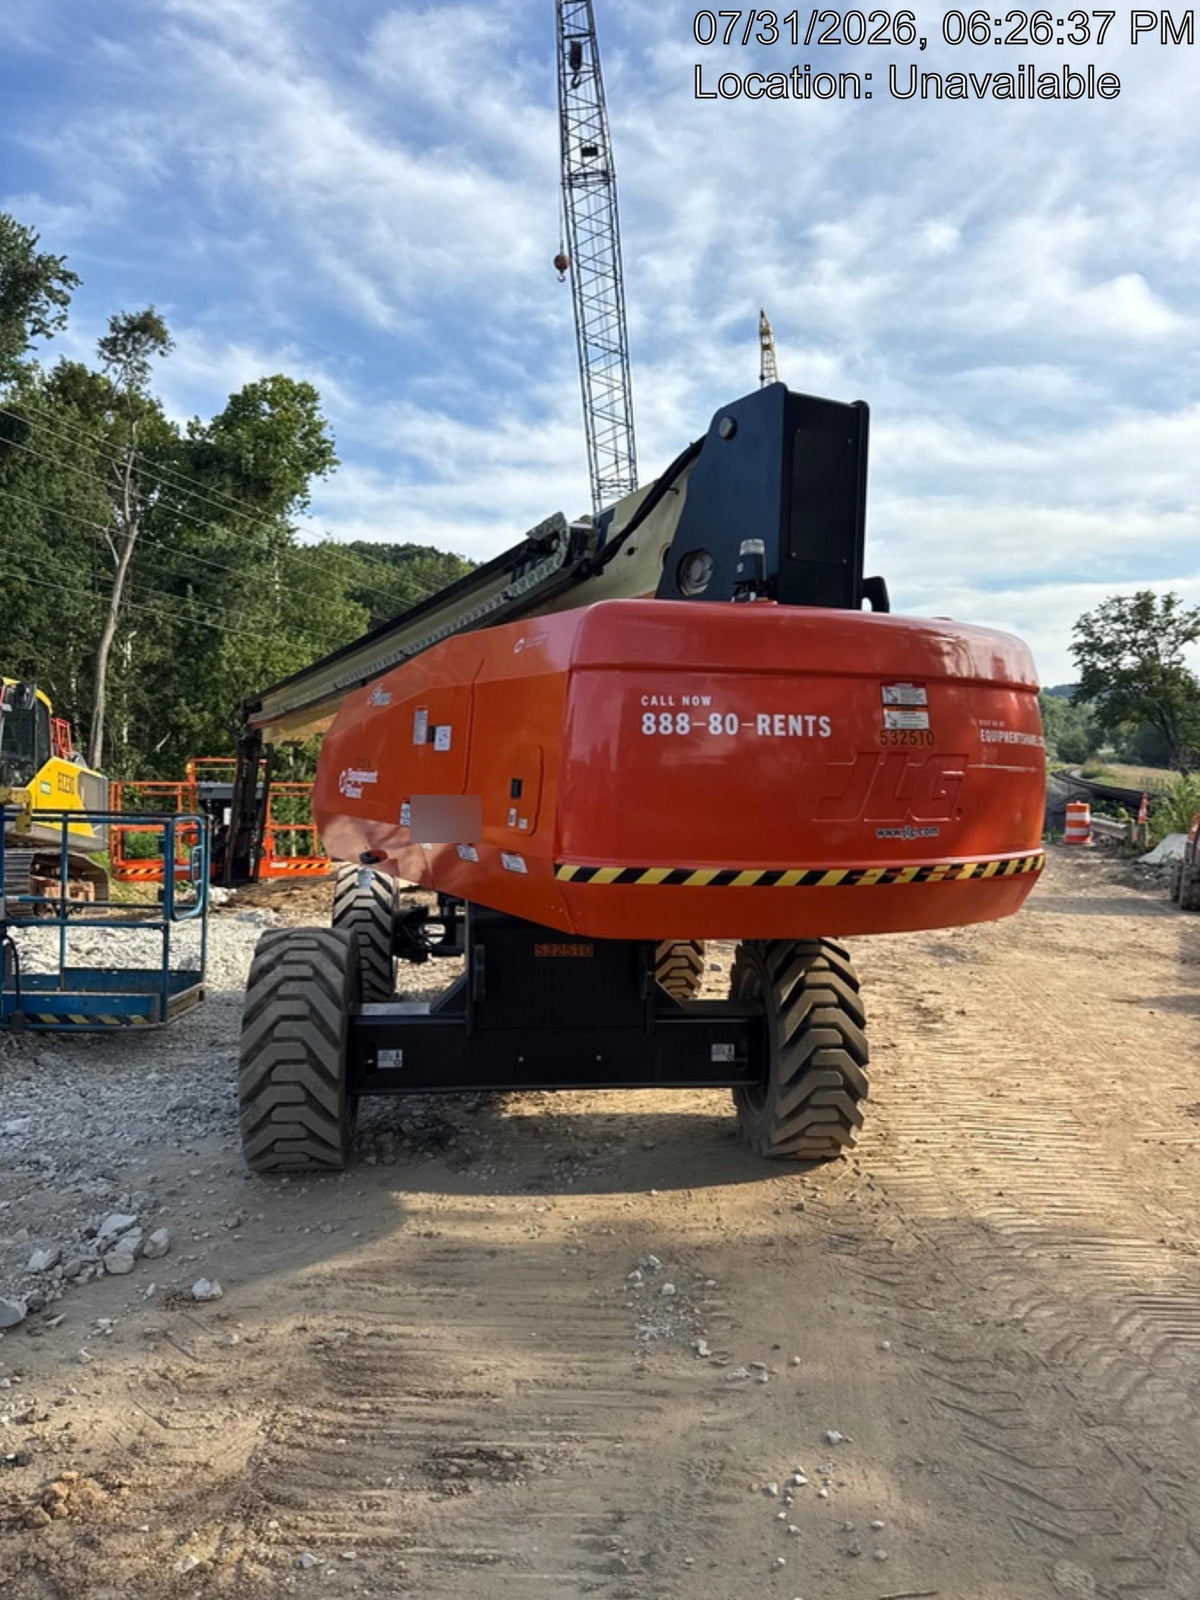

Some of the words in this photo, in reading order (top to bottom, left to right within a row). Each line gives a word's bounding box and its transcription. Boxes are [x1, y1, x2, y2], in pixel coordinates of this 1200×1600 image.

[641, 695, 675, 707] CALL
[682, 695, 712, 707] NOW
[641, 712, 832, 737] 888-80-RENTS
[880, 730, 935, 746] 532510
